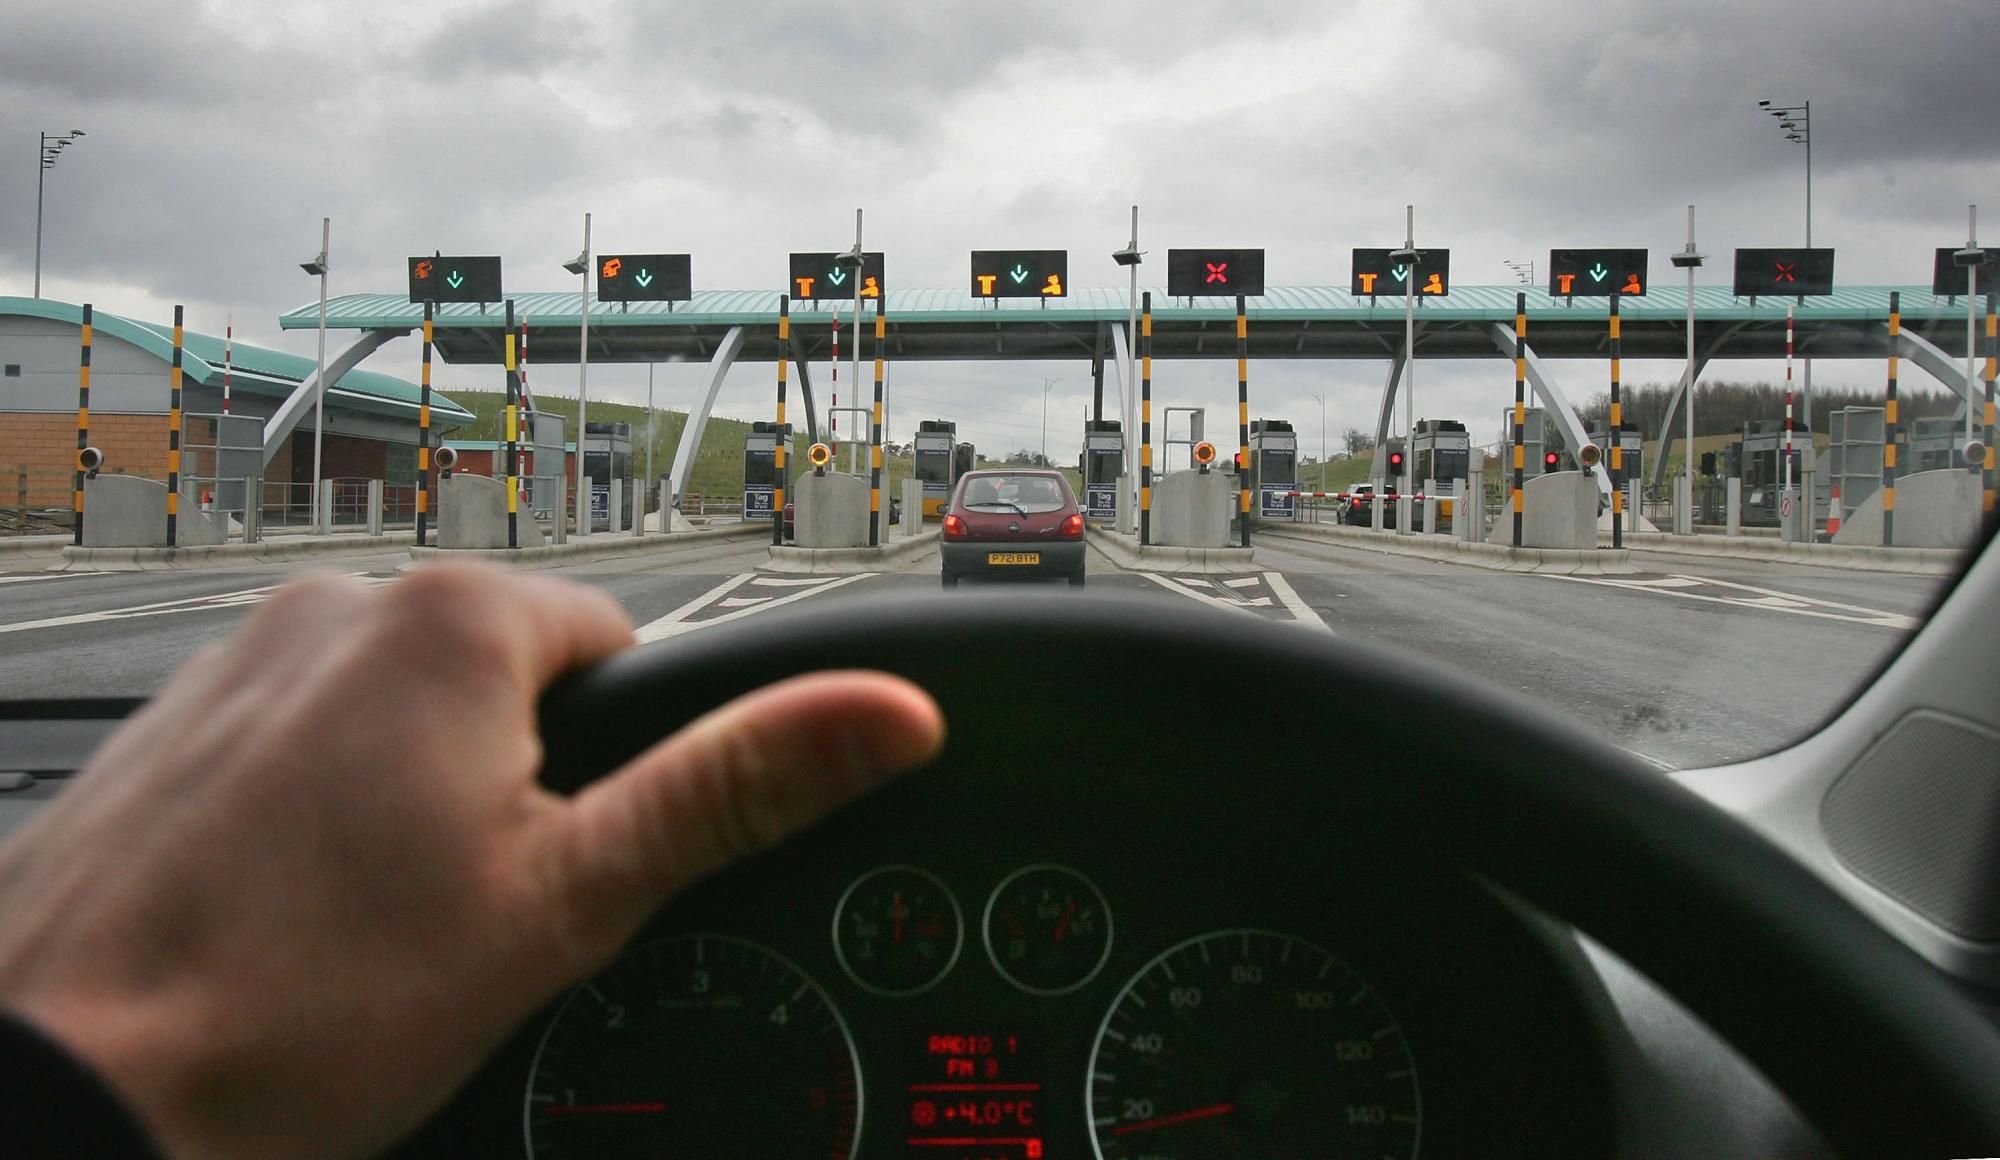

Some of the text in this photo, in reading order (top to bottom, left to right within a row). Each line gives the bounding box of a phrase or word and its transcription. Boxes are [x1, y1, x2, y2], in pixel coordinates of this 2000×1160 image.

[754, 493, 769, 503] Tag
[1097, 492, 1112, 502] Tag
[992, 554, 1037, 563] P721 BTH
[693, 969, 709, 993] 3
[1231, 964, 1262, 985] 80
[1169, 986, 1201, 1008] 60
[1296, 990, 1333, 1010] 100
[606, 1004, 625, 1029] 2
[769, 1003, 788, 1025] 4
[928, 1036, 992, 1054] RADIO
[1132, 1033, 1163, 1055] 40
[1335, 1041, 1373, 1060] 120
[947, 1059, 973, 1078] FM
[565, 1088, 576, 1106] 1
[1123, 1098, 1153, 1120] 20
[1346, 1104, 1386, 1124] 140
